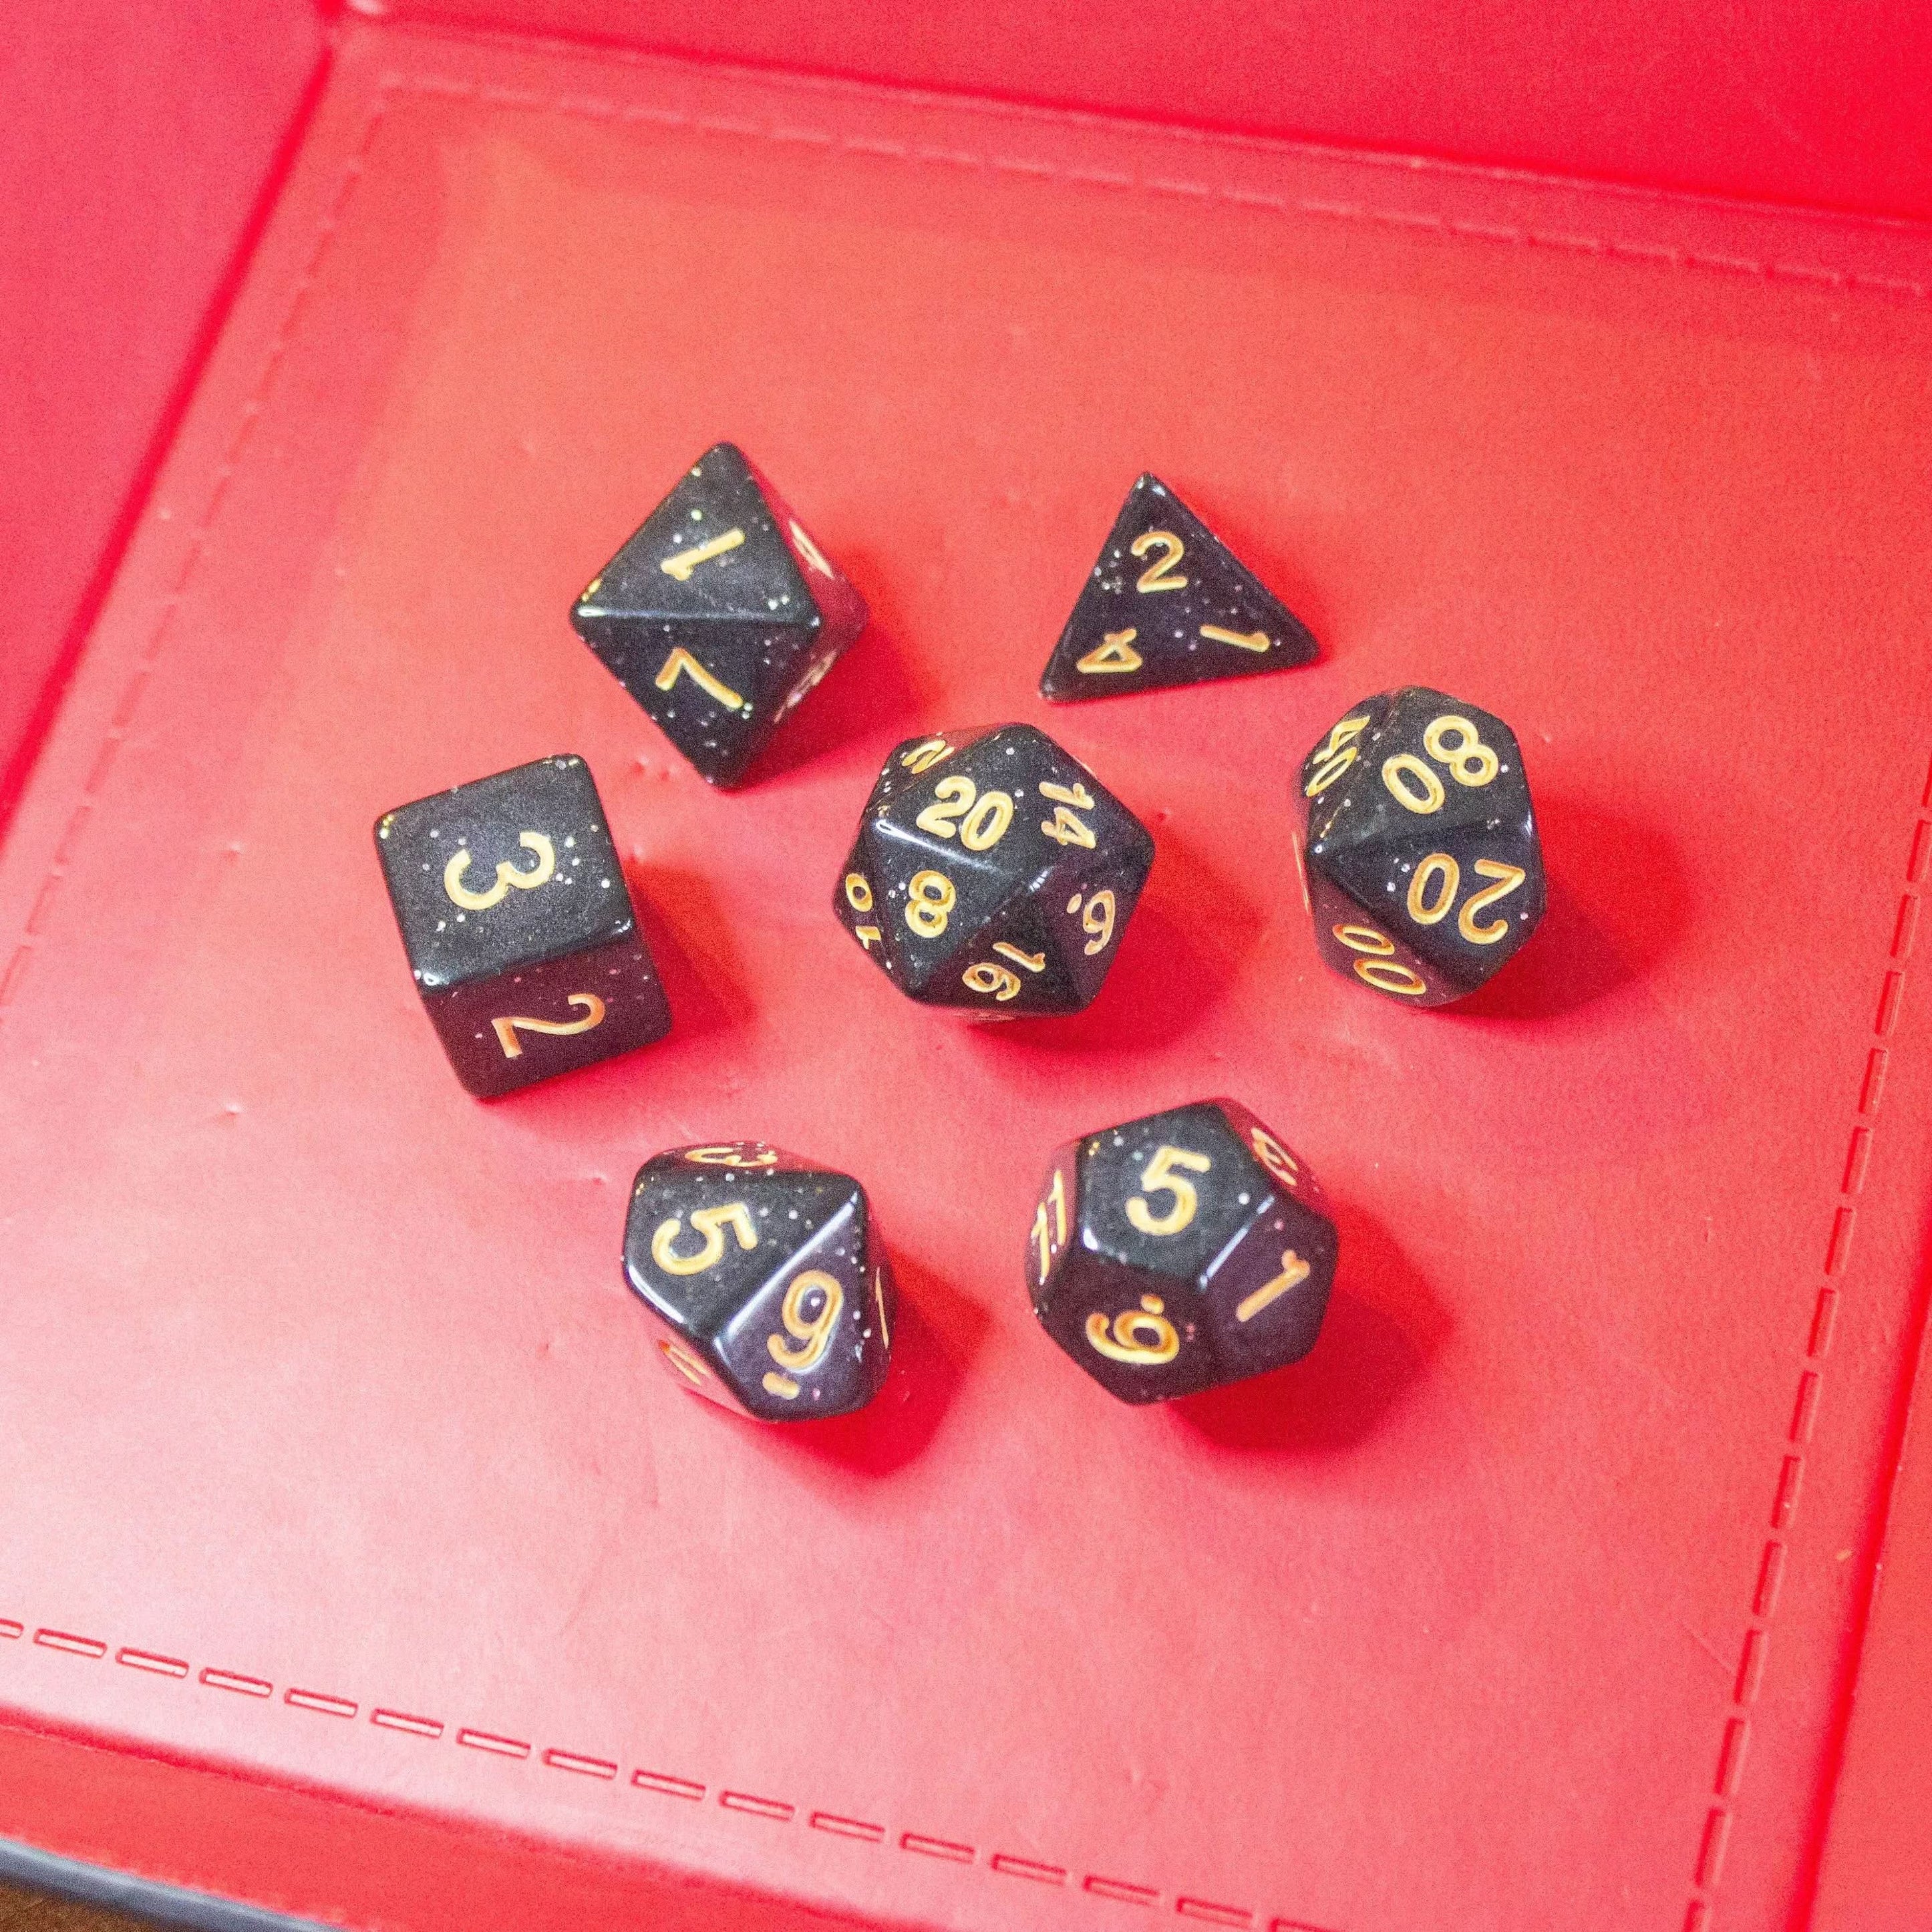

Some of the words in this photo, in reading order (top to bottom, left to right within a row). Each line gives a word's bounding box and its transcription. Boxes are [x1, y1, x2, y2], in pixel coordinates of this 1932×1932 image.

[660, 528, 745, 581] 1
[1131, 531, 1188, 593] 2
[1076, 628, 1143, 673] 4
[1200, 624, 1271, 653] 1
[655, 647, 743, 709] 7
[1306, 715, 1371, 798] 40
[1382, 715, 1499, 814] 80
[916, 776, 1014, 851] 20
[1039, 781, 1096, 849] 14
[444, 831, 555, 911] 3
[905, 870, 957, 938] 8
[1407, 852, 1526, 945] 20
[962, 941, 1046, 1001] 16
[1332, 925, 1426, 995] 00
[491, 993, 605, 1059] 2
[1030, 1170, 1067, 1280] 11
[1125, 1145, 1211, 1236] 5
[651, 1201, 758, 1276] 5
[1236, 1249, 1310, 1322] 1
